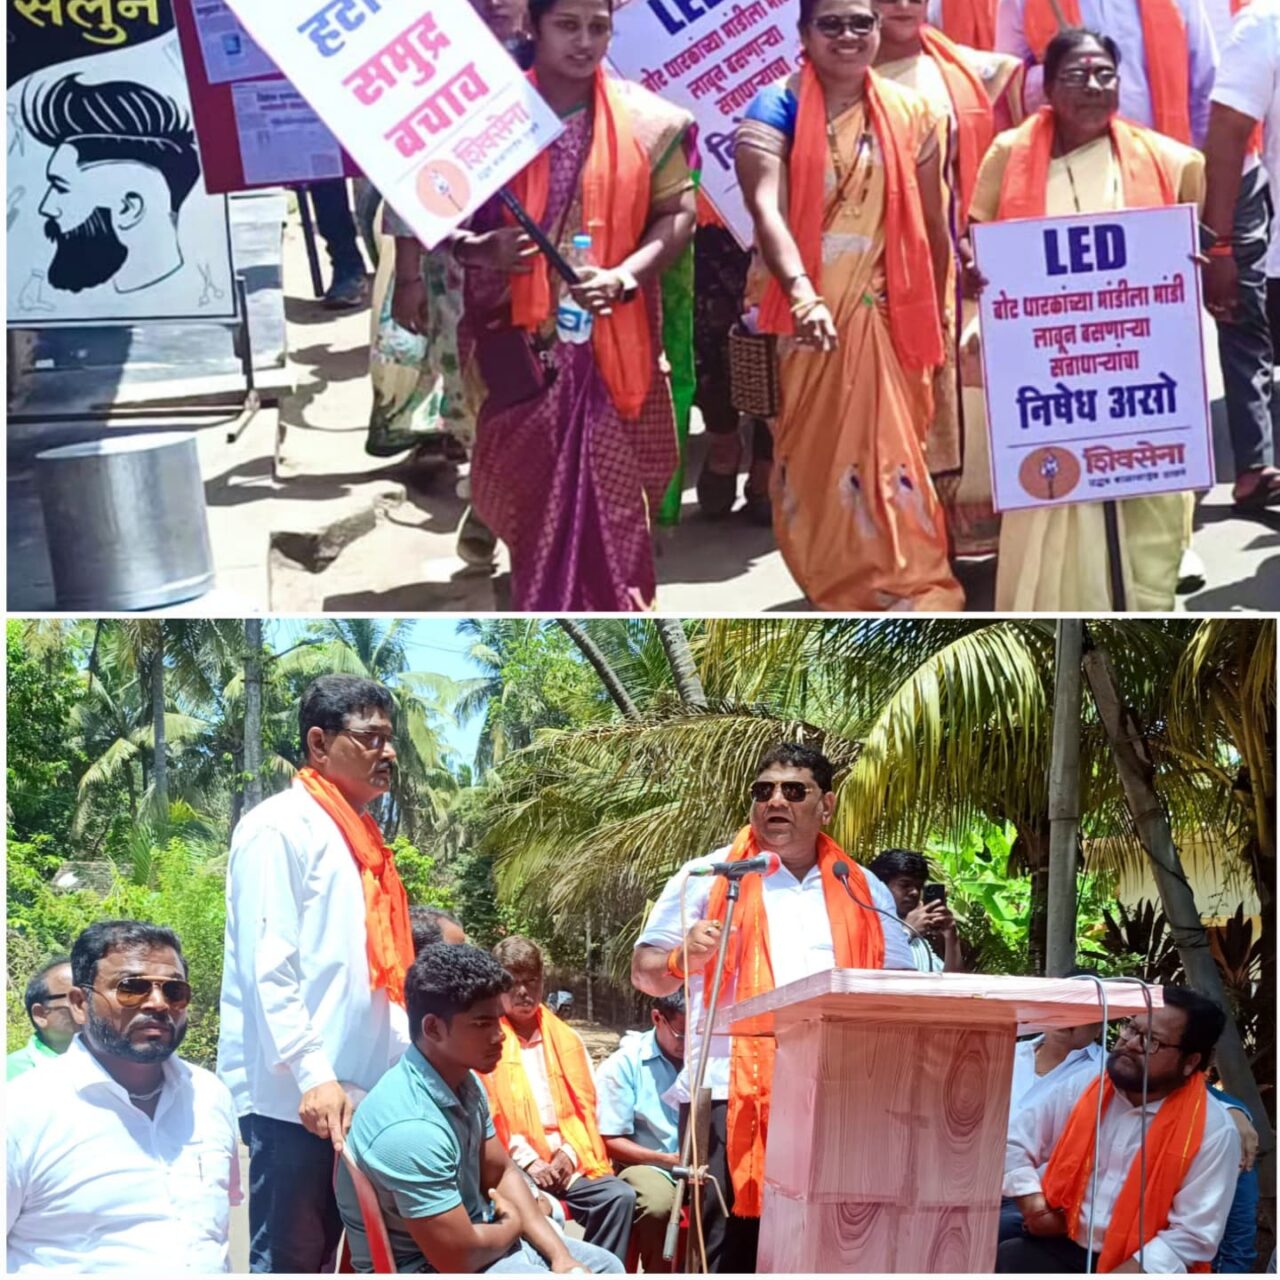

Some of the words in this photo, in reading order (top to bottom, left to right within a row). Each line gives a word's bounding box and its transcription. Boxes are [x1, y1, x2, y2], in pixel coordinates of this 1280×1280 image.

[342, 11, 451, 107] समुद्र
[384, 61, 490, 159] बचाव
[1043, 223, 1128, 277] LED
[1097, 278, 1150, 311] मांडीला
[1153, 273, 1185, 305] मांडी
[1033, 326, 1077, 354] लावून
[1016, 382, 1098, 430] निषेध
[1107, 372, 1178, 420] असो
[1082, 441, 1186, 474] शिवसेना
